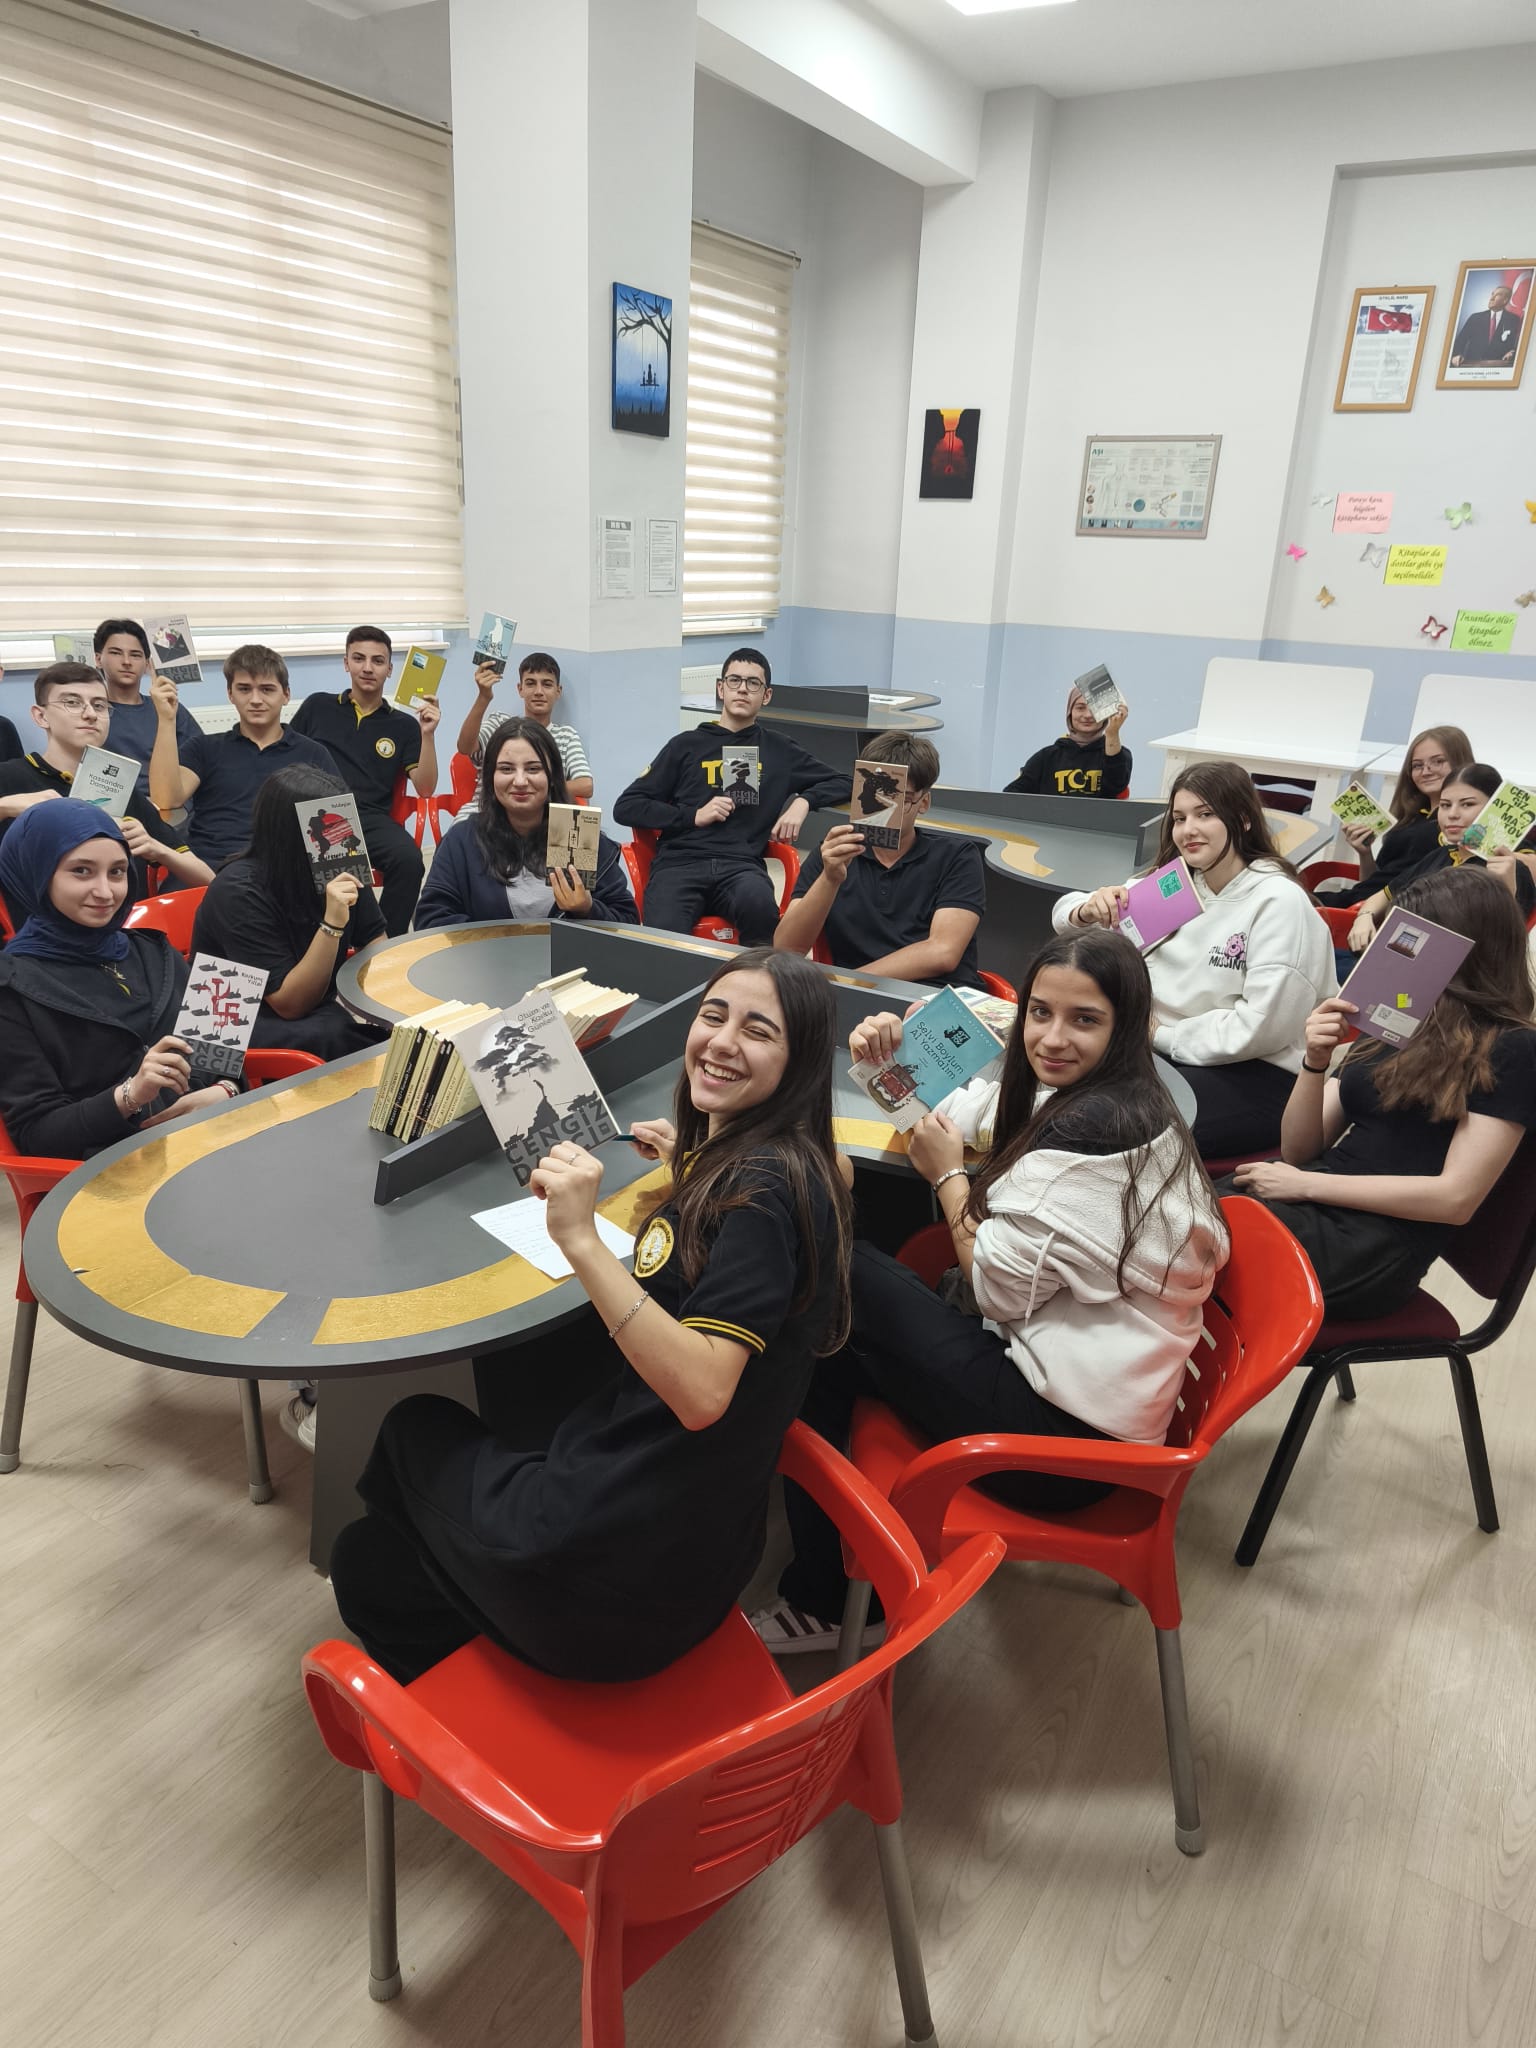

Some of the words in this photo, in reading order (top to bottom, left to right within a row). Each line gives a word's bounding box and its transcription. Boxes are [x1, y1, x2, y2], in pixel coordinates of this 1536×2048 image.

[1510, 786, 1530, 801] CEN
[1492, 798, 1513, 812] AYT
[1501, 812, 1518, 826] MA
[1504, 822, 1523, 838] TOV
[915, 1020, 939, 1043] Selvi
[933, 1041, 967, 1075] Boylum
[916, 1038, 959, 1079] Yazmalım
